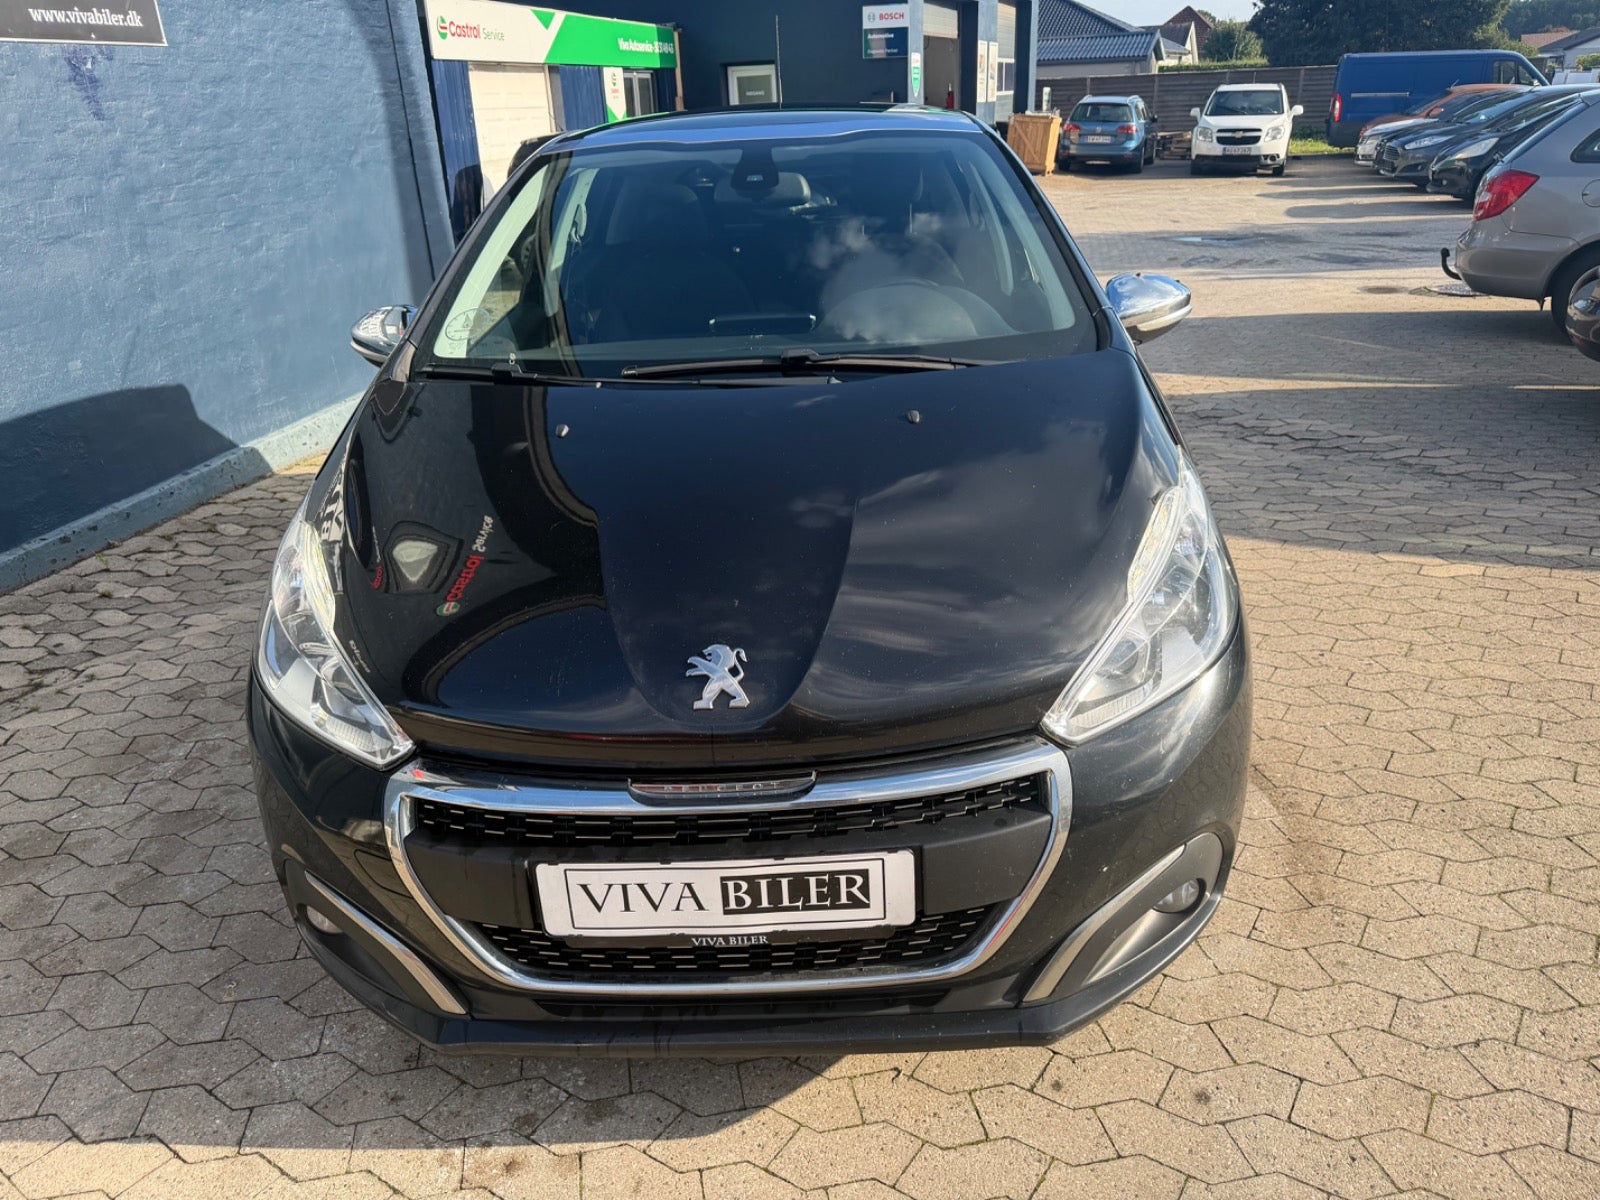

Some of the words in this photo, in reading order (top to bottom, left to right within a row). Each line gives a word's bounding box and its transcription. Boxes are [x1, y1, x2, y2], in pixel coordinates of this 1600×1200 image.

[28, 7, 144, 27] www.vivabiler.dk
[879, 12, 905, 21] BOSCH
[449, 20, 481, 39] Castrol
[482, 27, 505, 41] Service
[576, 882, 709, 913] VIVA
[722, 873, 871, 911] BILER
[691, 936, 726, 946] VIVA
[729, 934, 769, 945] BILER
